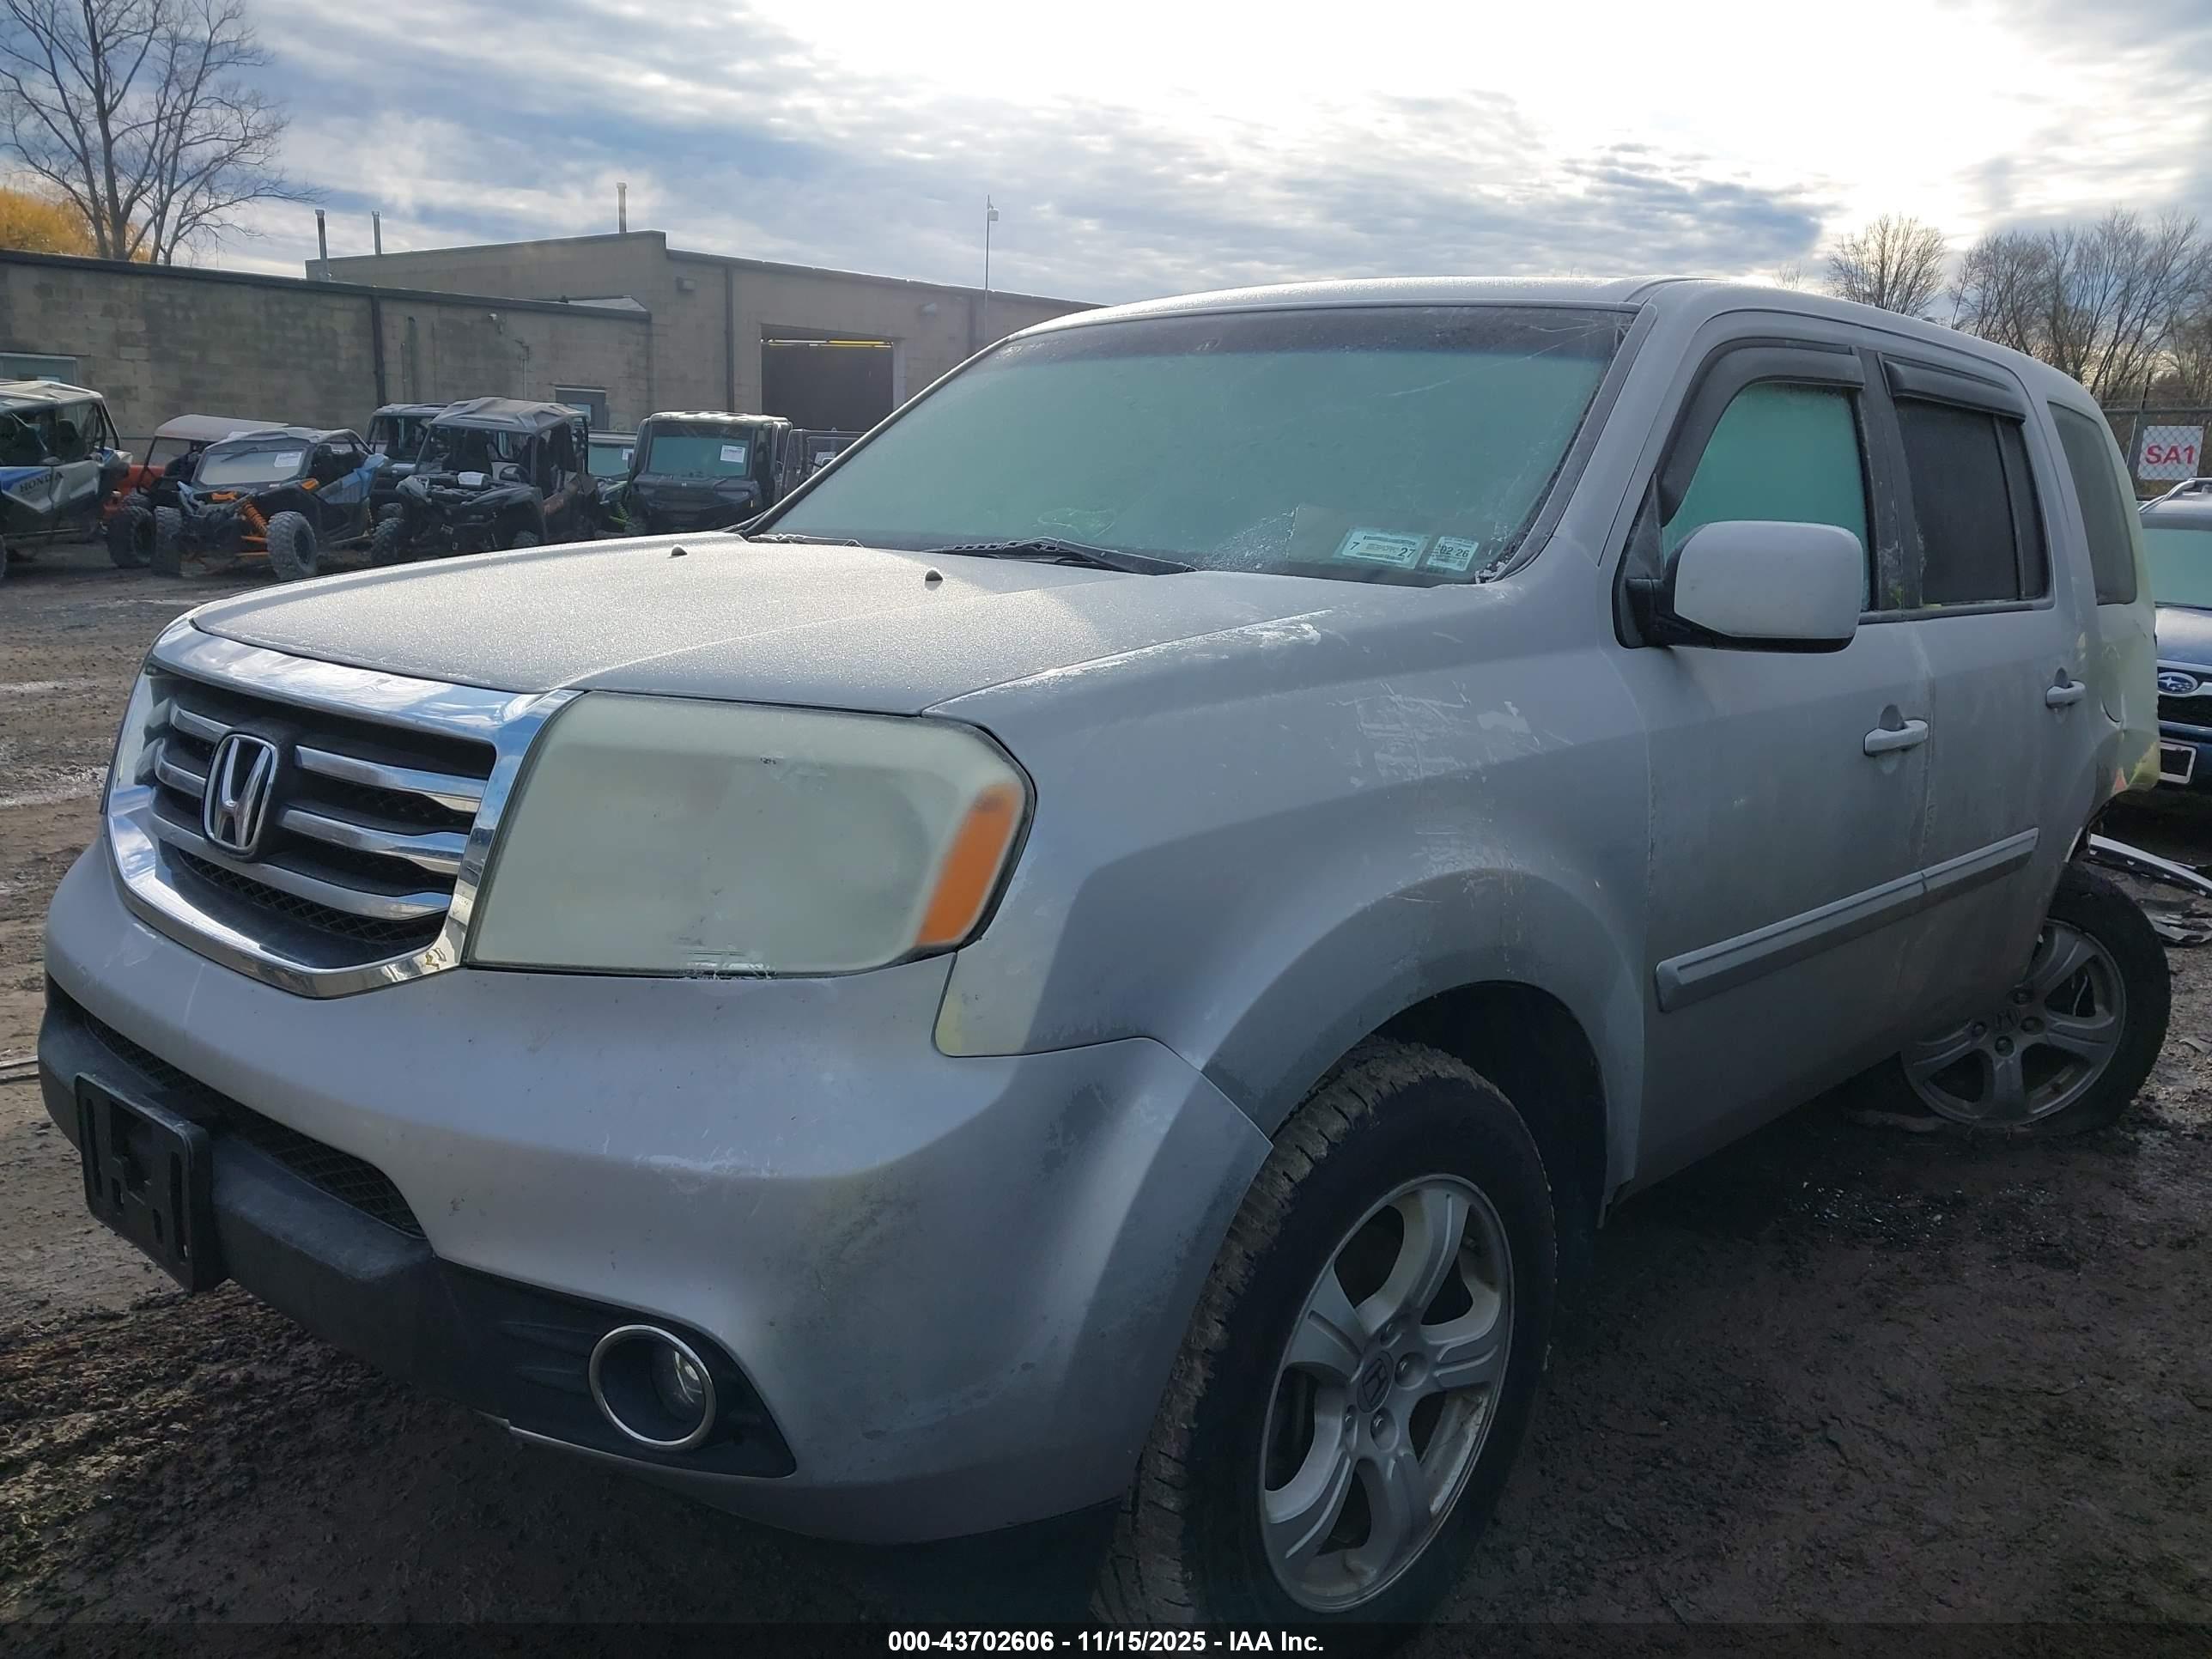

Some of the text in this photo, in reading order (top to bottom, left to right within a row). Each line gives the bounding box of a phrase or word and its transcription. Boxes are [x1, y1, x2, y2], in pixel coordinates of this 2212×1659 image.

[2145, 443, 2196, 465] SA1
[20, 471, 64, 493] HONDA
[1350, 541, 1360, 550] 7
[1397, 547, 1416, 558] 27
[1455, 548, 1470, 558] 26
